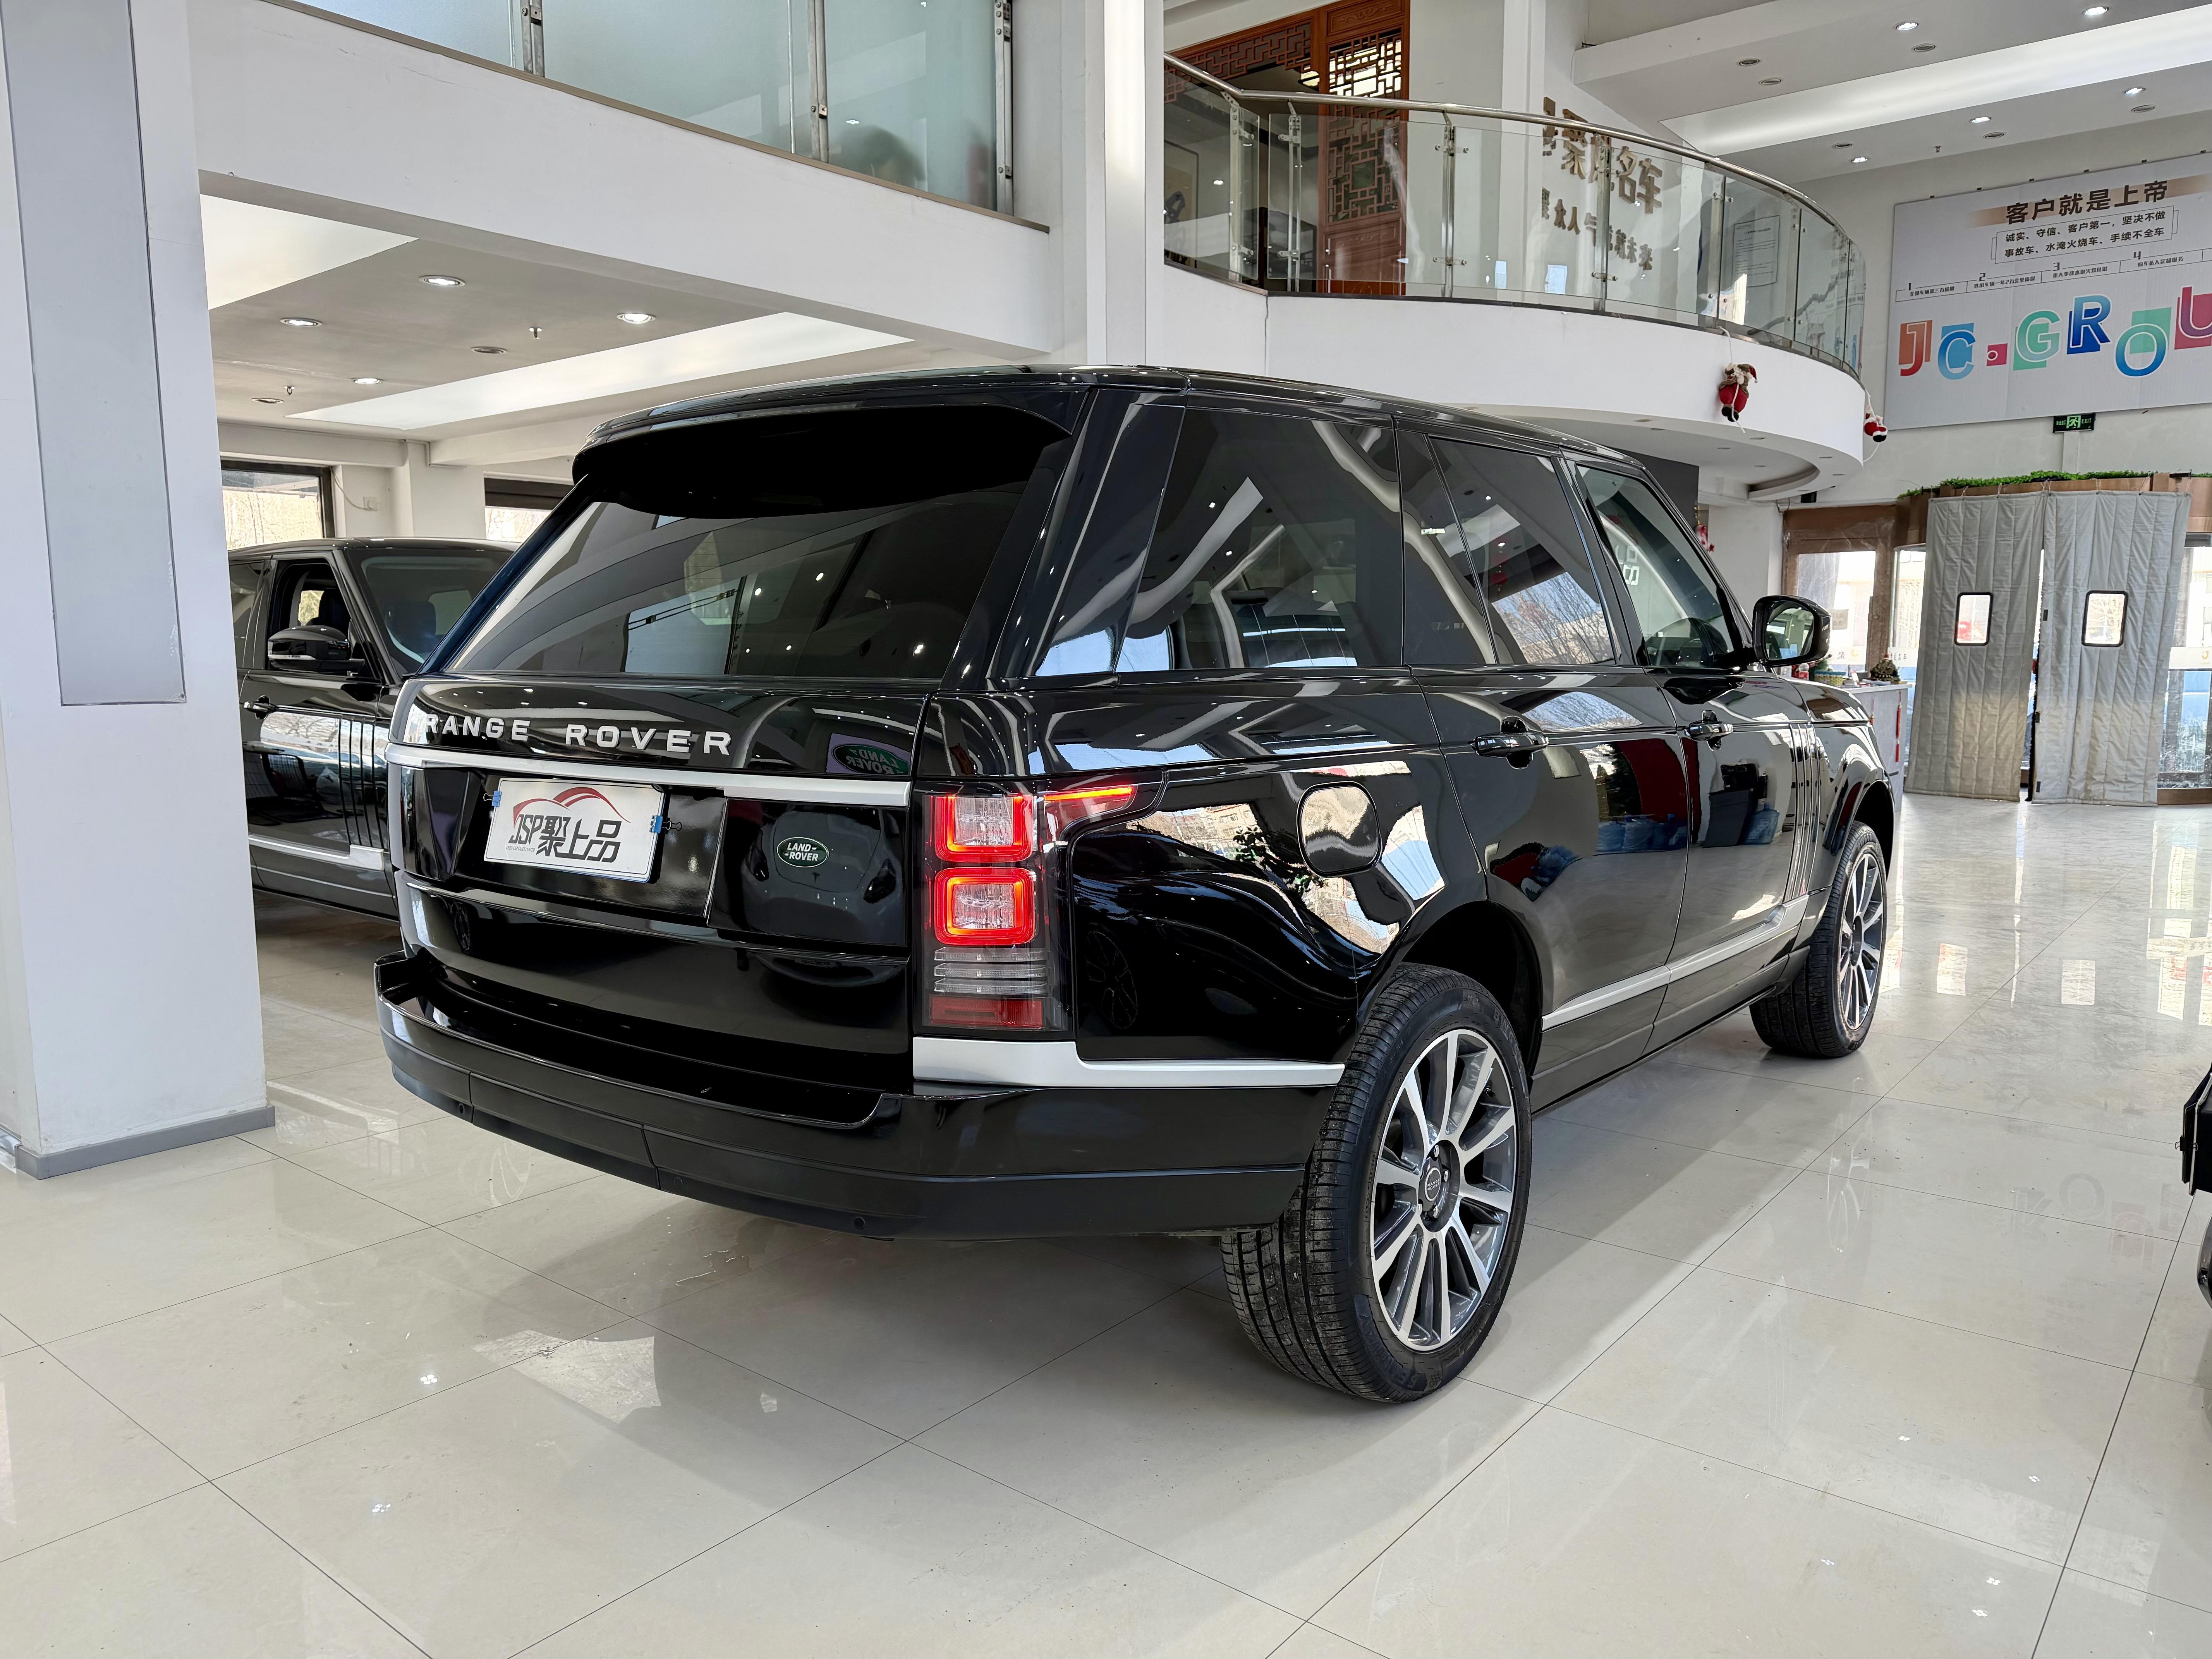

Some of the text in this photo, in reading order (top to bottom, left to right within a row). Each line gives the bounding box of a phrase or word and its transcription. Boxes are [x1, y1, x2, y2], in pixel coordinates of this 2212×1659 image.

[2006, 180, 2167, 224] 客户就是上帝
[2133, 251, 2141, 259] 4
[2053, 262, 2060, 271] 3
[1979, 273, 1985, 281] 2
[425, 713, 732, 756] RANGE ROVER
[787, 843, 811, 852] LAND
[789, 852, 819, 861] ROVER
